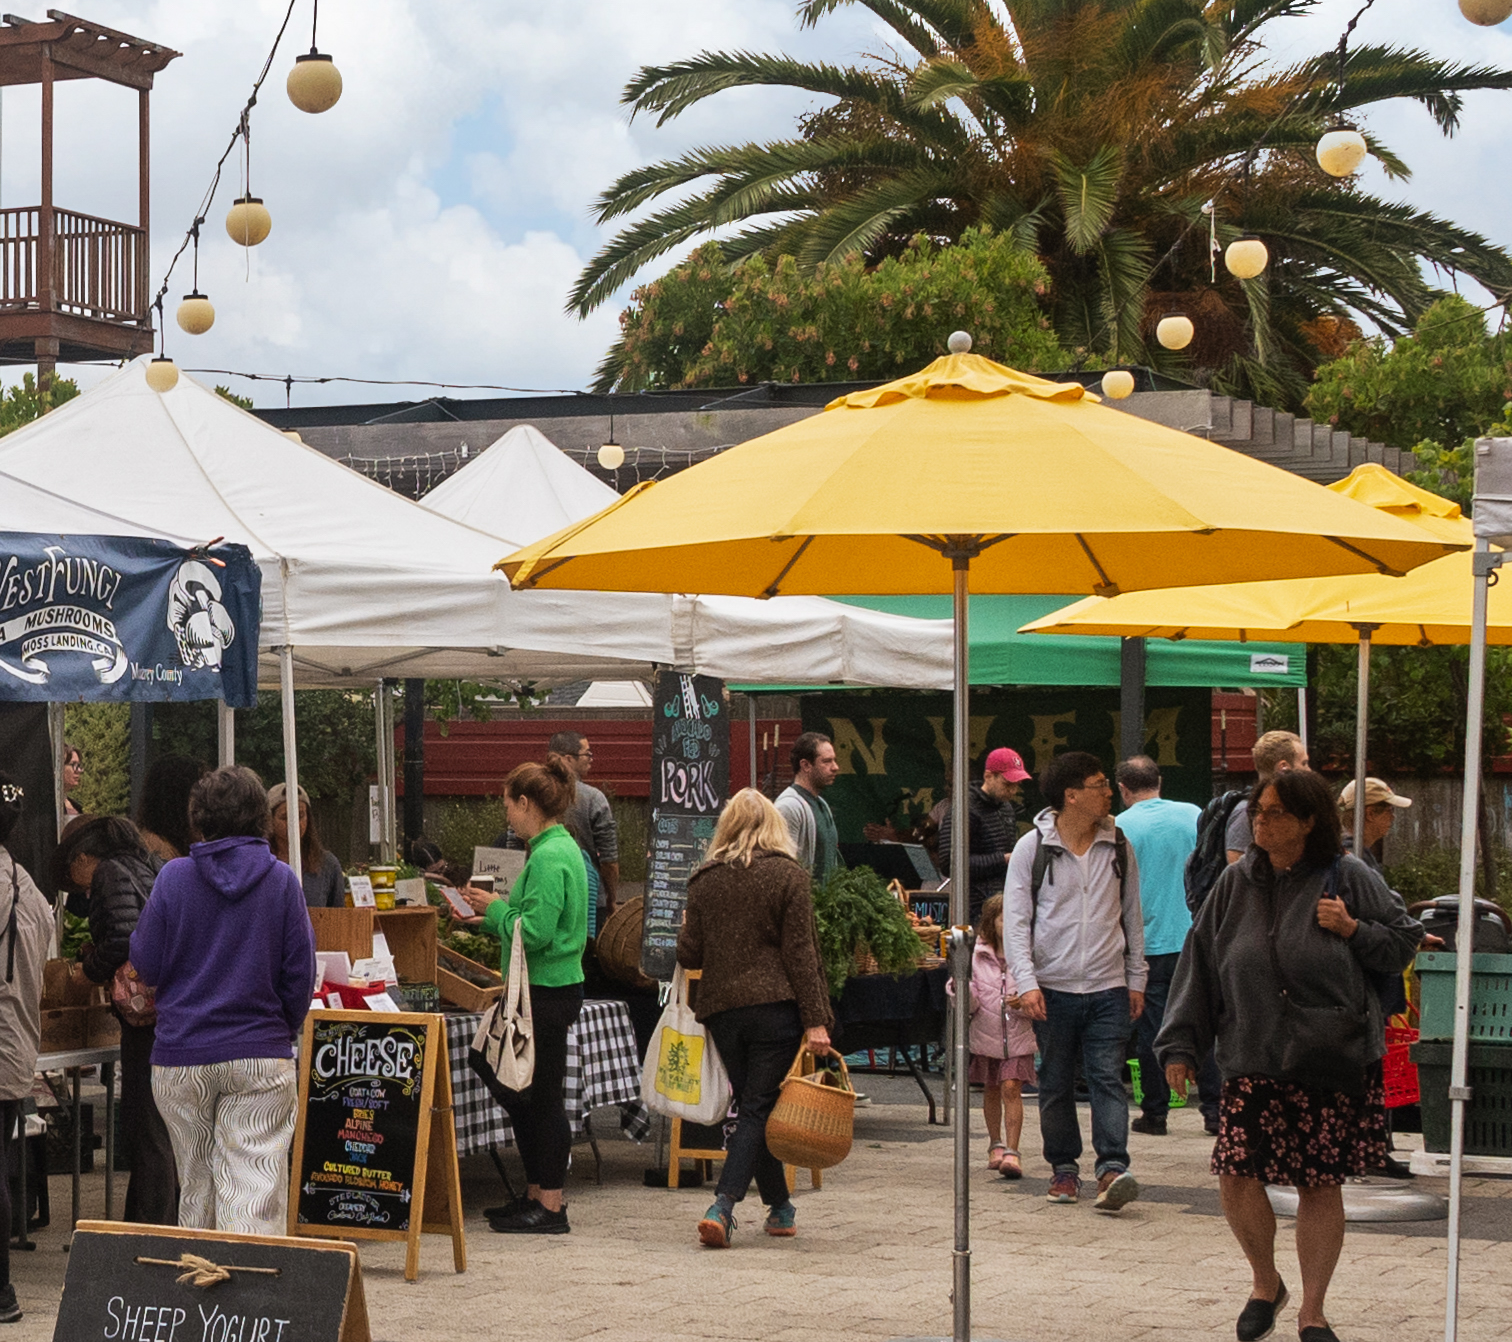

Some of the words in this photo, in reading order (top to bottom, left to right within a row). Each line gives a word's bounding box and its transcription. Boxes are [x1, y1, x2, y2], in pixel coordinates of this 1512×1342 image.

[24, 606, 114, 640] MUSHROOMS
[23, 636, 49, 654] MOSS
[156, 663, 183, 686] County
[660, 758, 720, 813] PORK
[479, 860, 501, 873] Little
[914, 901, 949, 923] MUSIC
[314, 1035, 414, 1079] CHEESE
[323, 1160, 361, 1176] CULTURED
[362, 1166, 393, 1181] BUTTER
[379, 1178, 404, 1193] HONEY
